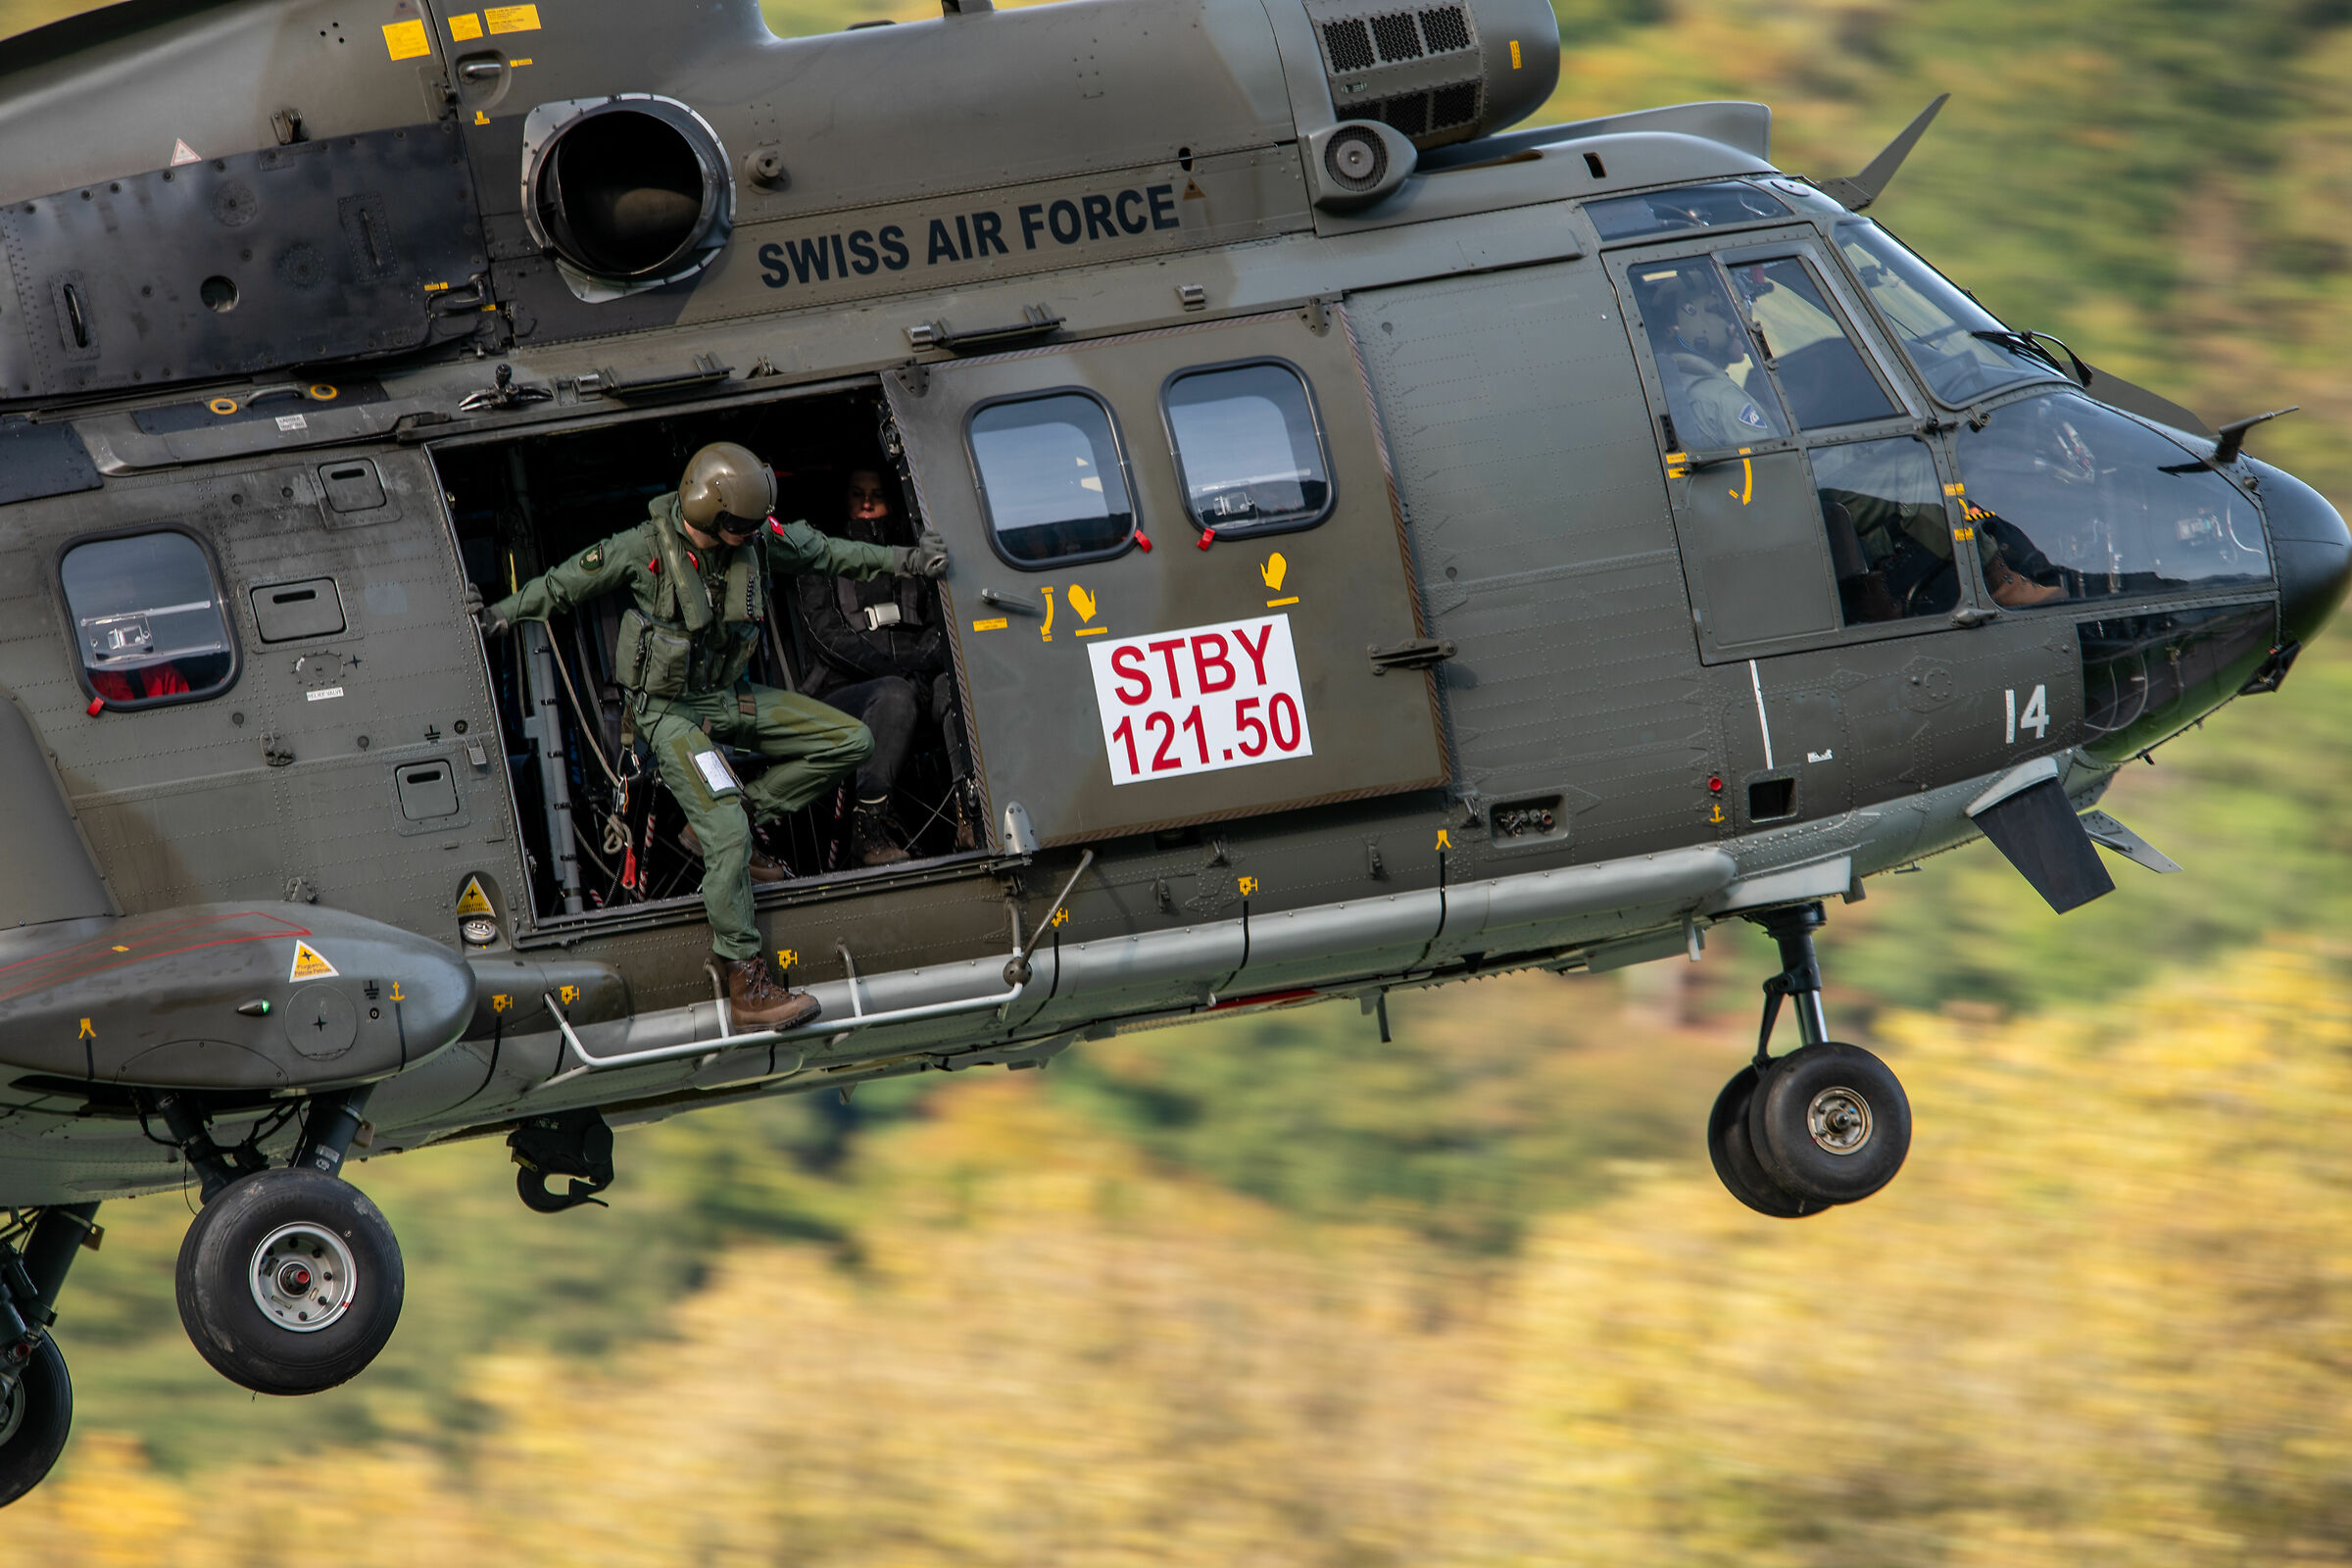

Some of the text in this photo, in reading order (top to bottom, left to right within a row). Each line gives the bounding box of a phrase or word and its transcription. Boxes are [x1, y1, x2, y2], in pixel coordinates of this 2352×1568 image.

[758, 183, 1181, 288] SWISS AIR FORCE
[1110, 623, 1273, 706] STBY
[1112, 692, 1301, 775] 121.50
[2004, 684, 2050, 744] 14
